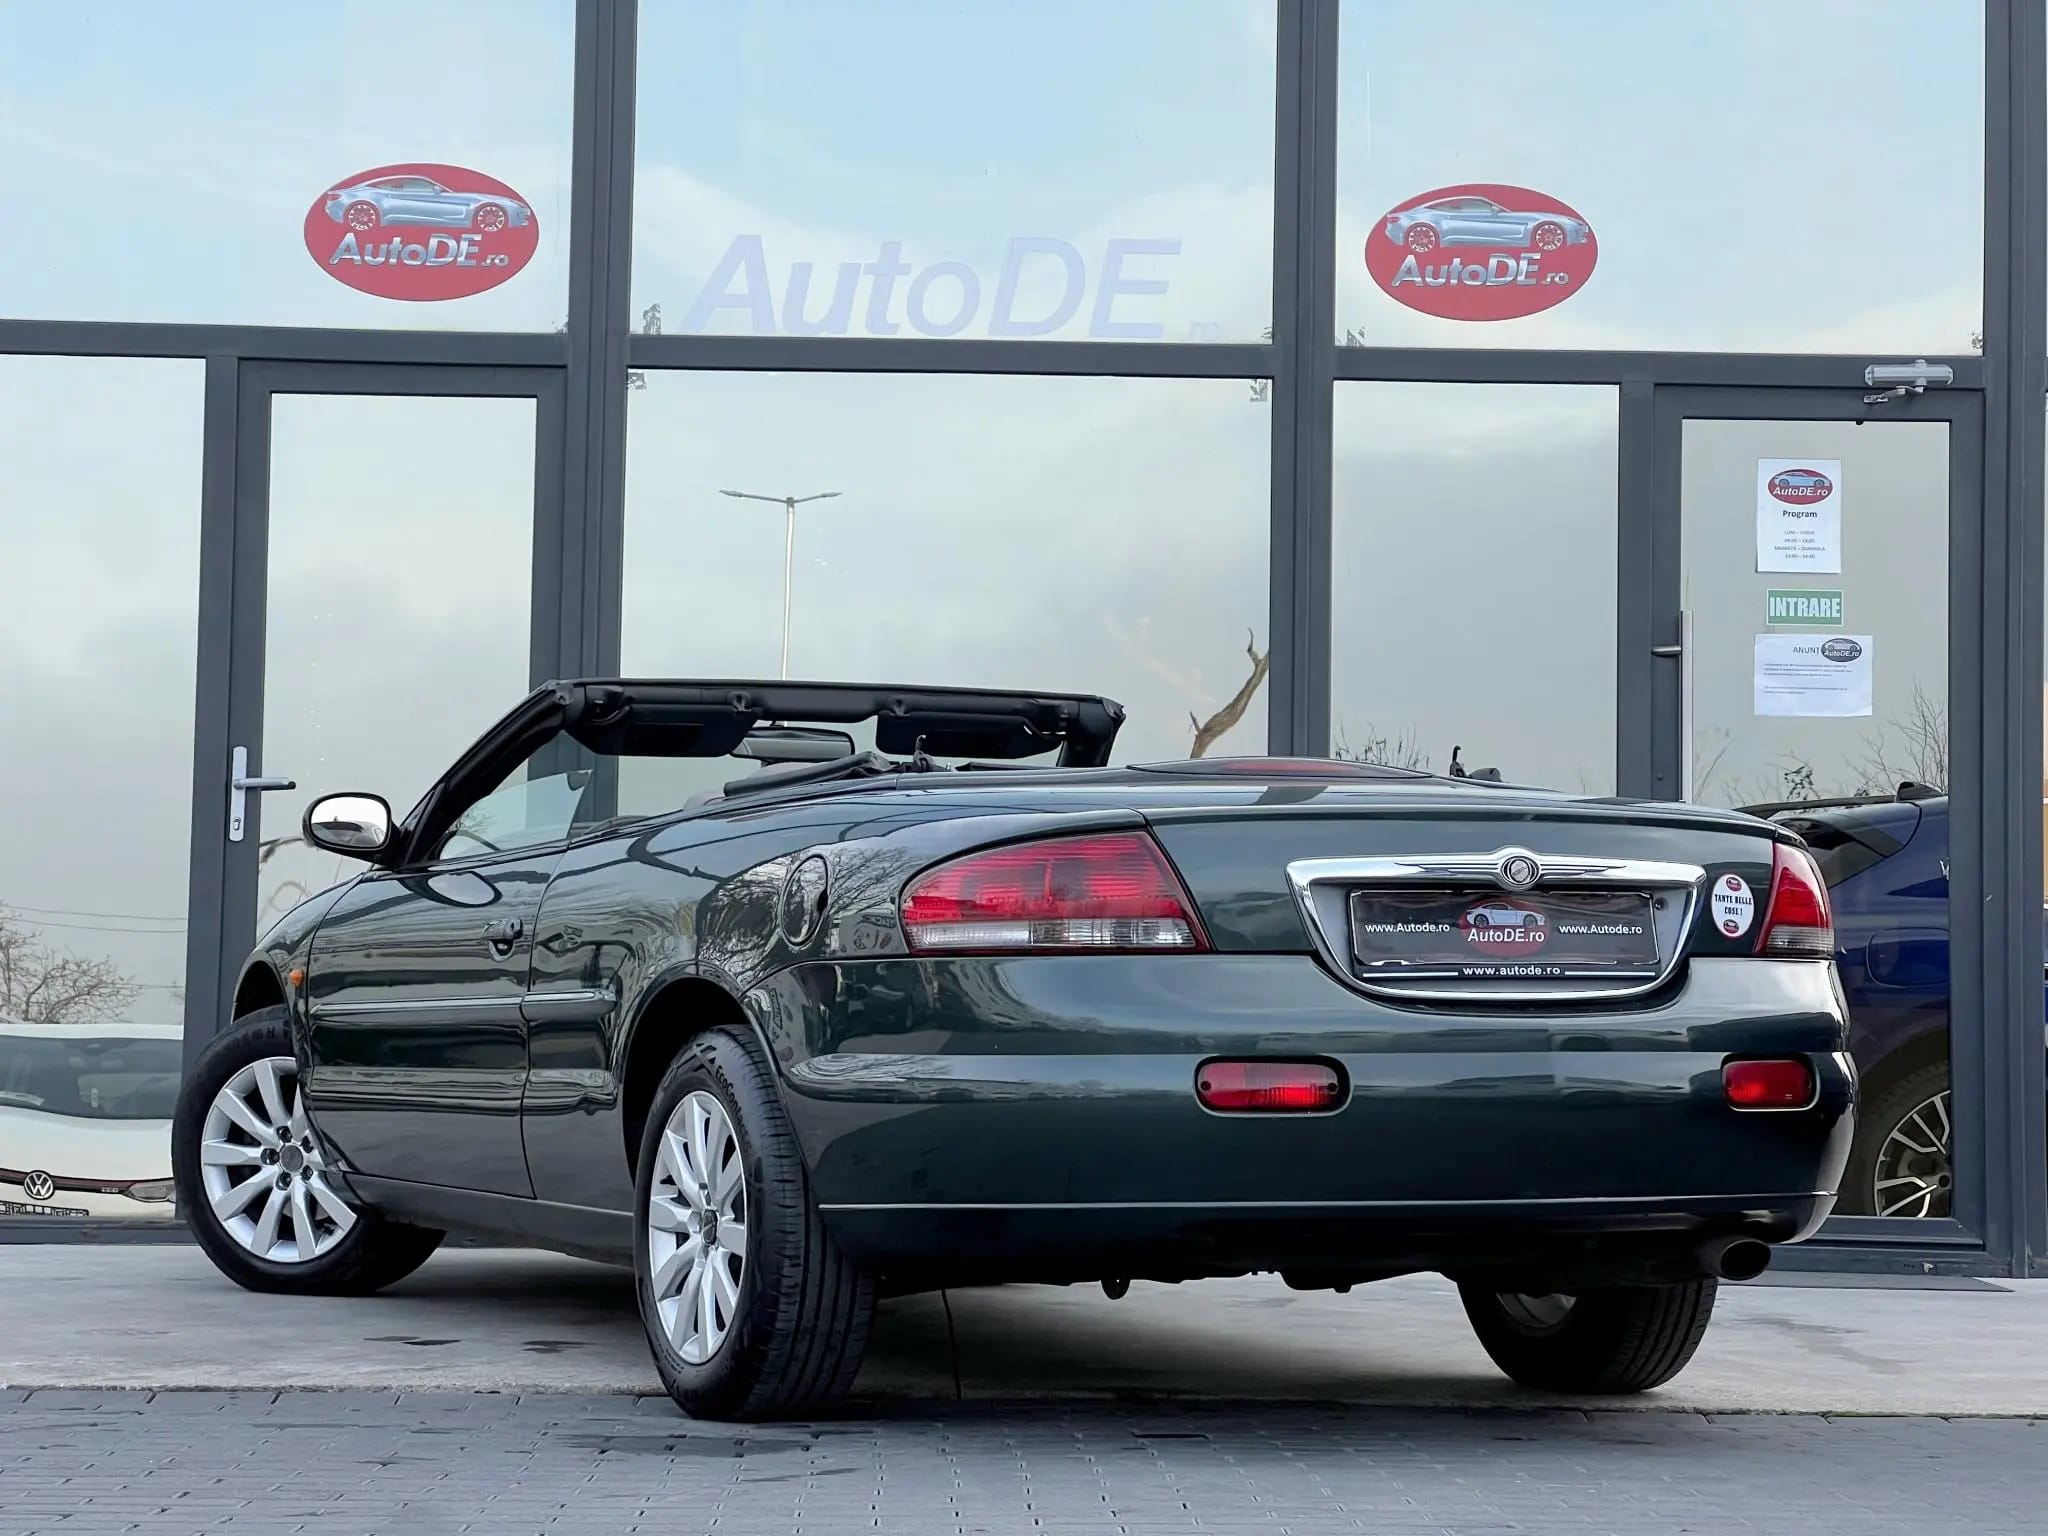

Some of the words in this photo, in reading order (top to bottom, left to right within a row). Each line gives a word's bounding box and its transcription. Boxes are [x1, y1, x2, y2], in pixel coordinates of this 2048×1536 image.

[1772, 486, 1829, 496] AutoDE.ro
[1782, 510, 1818, 519] Program
[1769, 596, 1841, 618] INTRARE
[1714, 893, 1734, 904] TANTE
[1735, 896, 1753, 906] BELLE
[1364, 922, 1451, 934] www.Autode.ro
[1558, 923, 1643, 936] www.Autode.ro
[1467, 927, 1545, 943] AutoDE.ro
[1462, 965, 1561, 976] www.autode.ro
